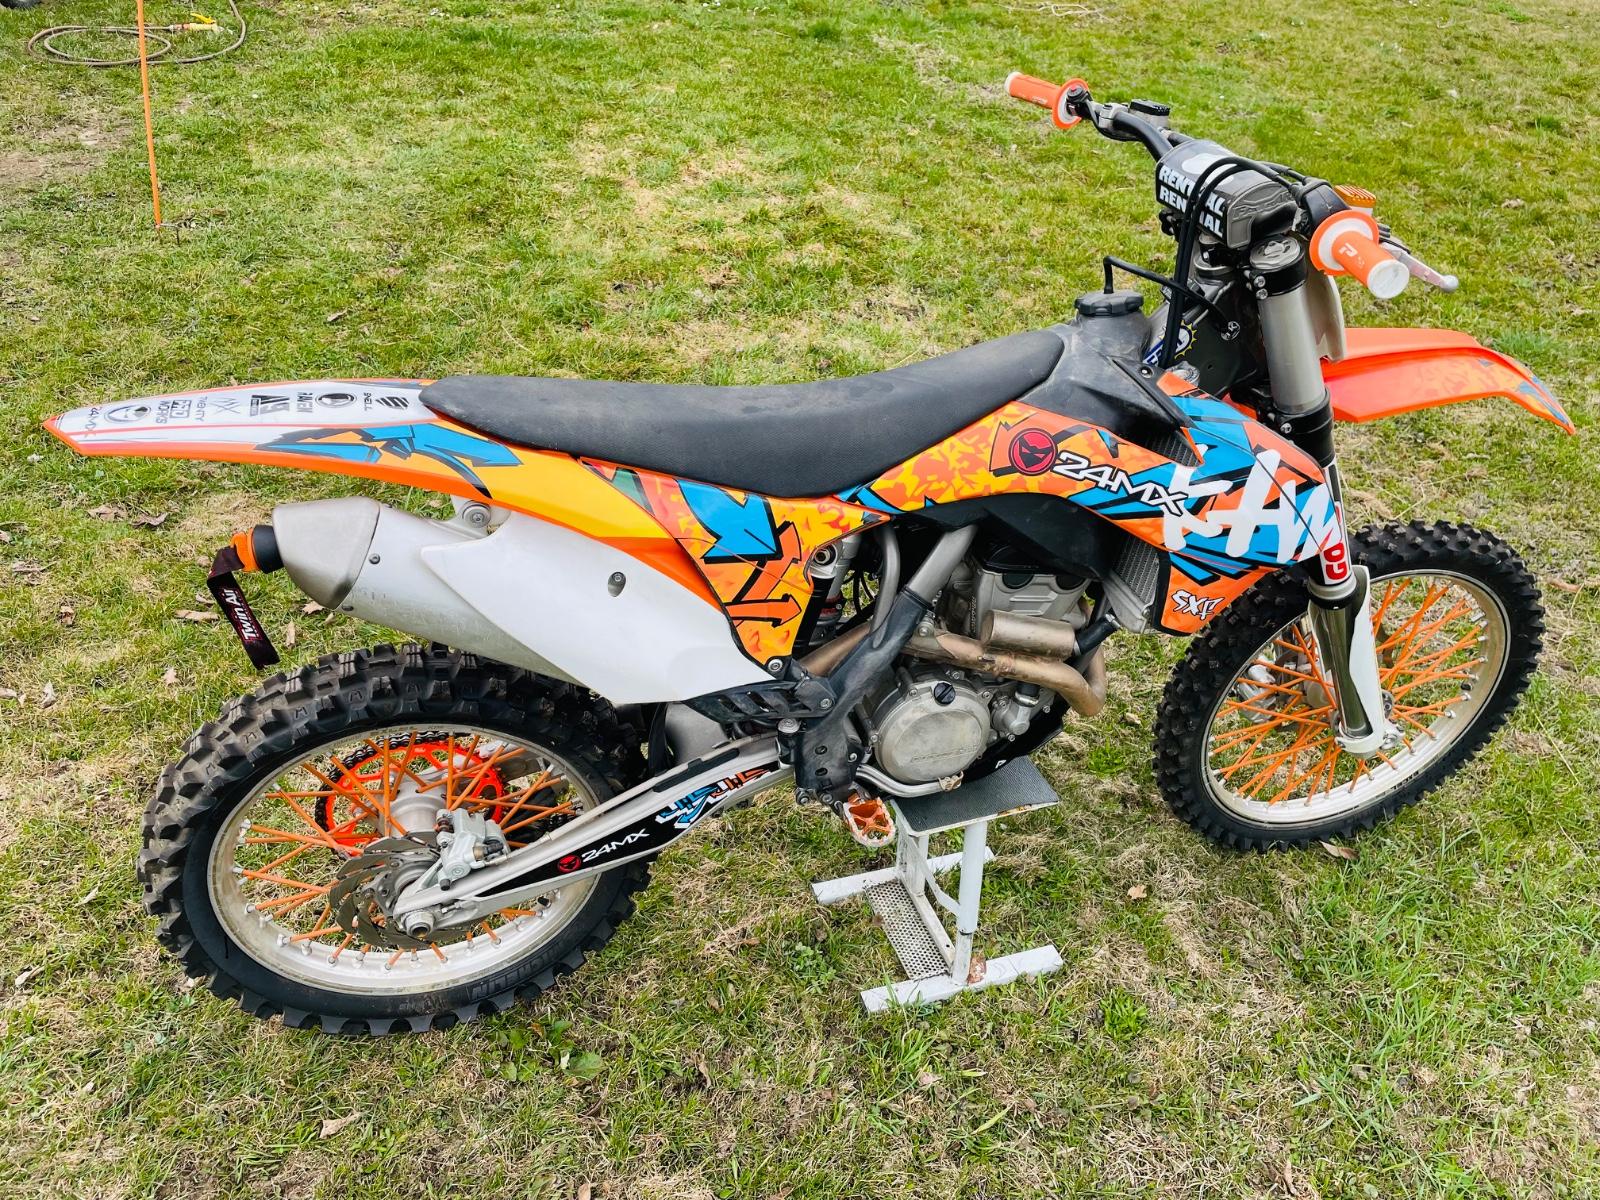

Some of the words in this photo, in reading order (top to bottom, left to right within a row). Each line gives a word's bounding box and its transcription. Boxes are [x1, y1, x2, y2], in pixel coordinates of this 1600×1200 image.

[1158, 164, 1227, 217] RENTAL
[1158, 185, 1225, 239] RENAL
[1050, 451, 1188, 517] 24MX
[581, 827, 650, 863] 24MX
